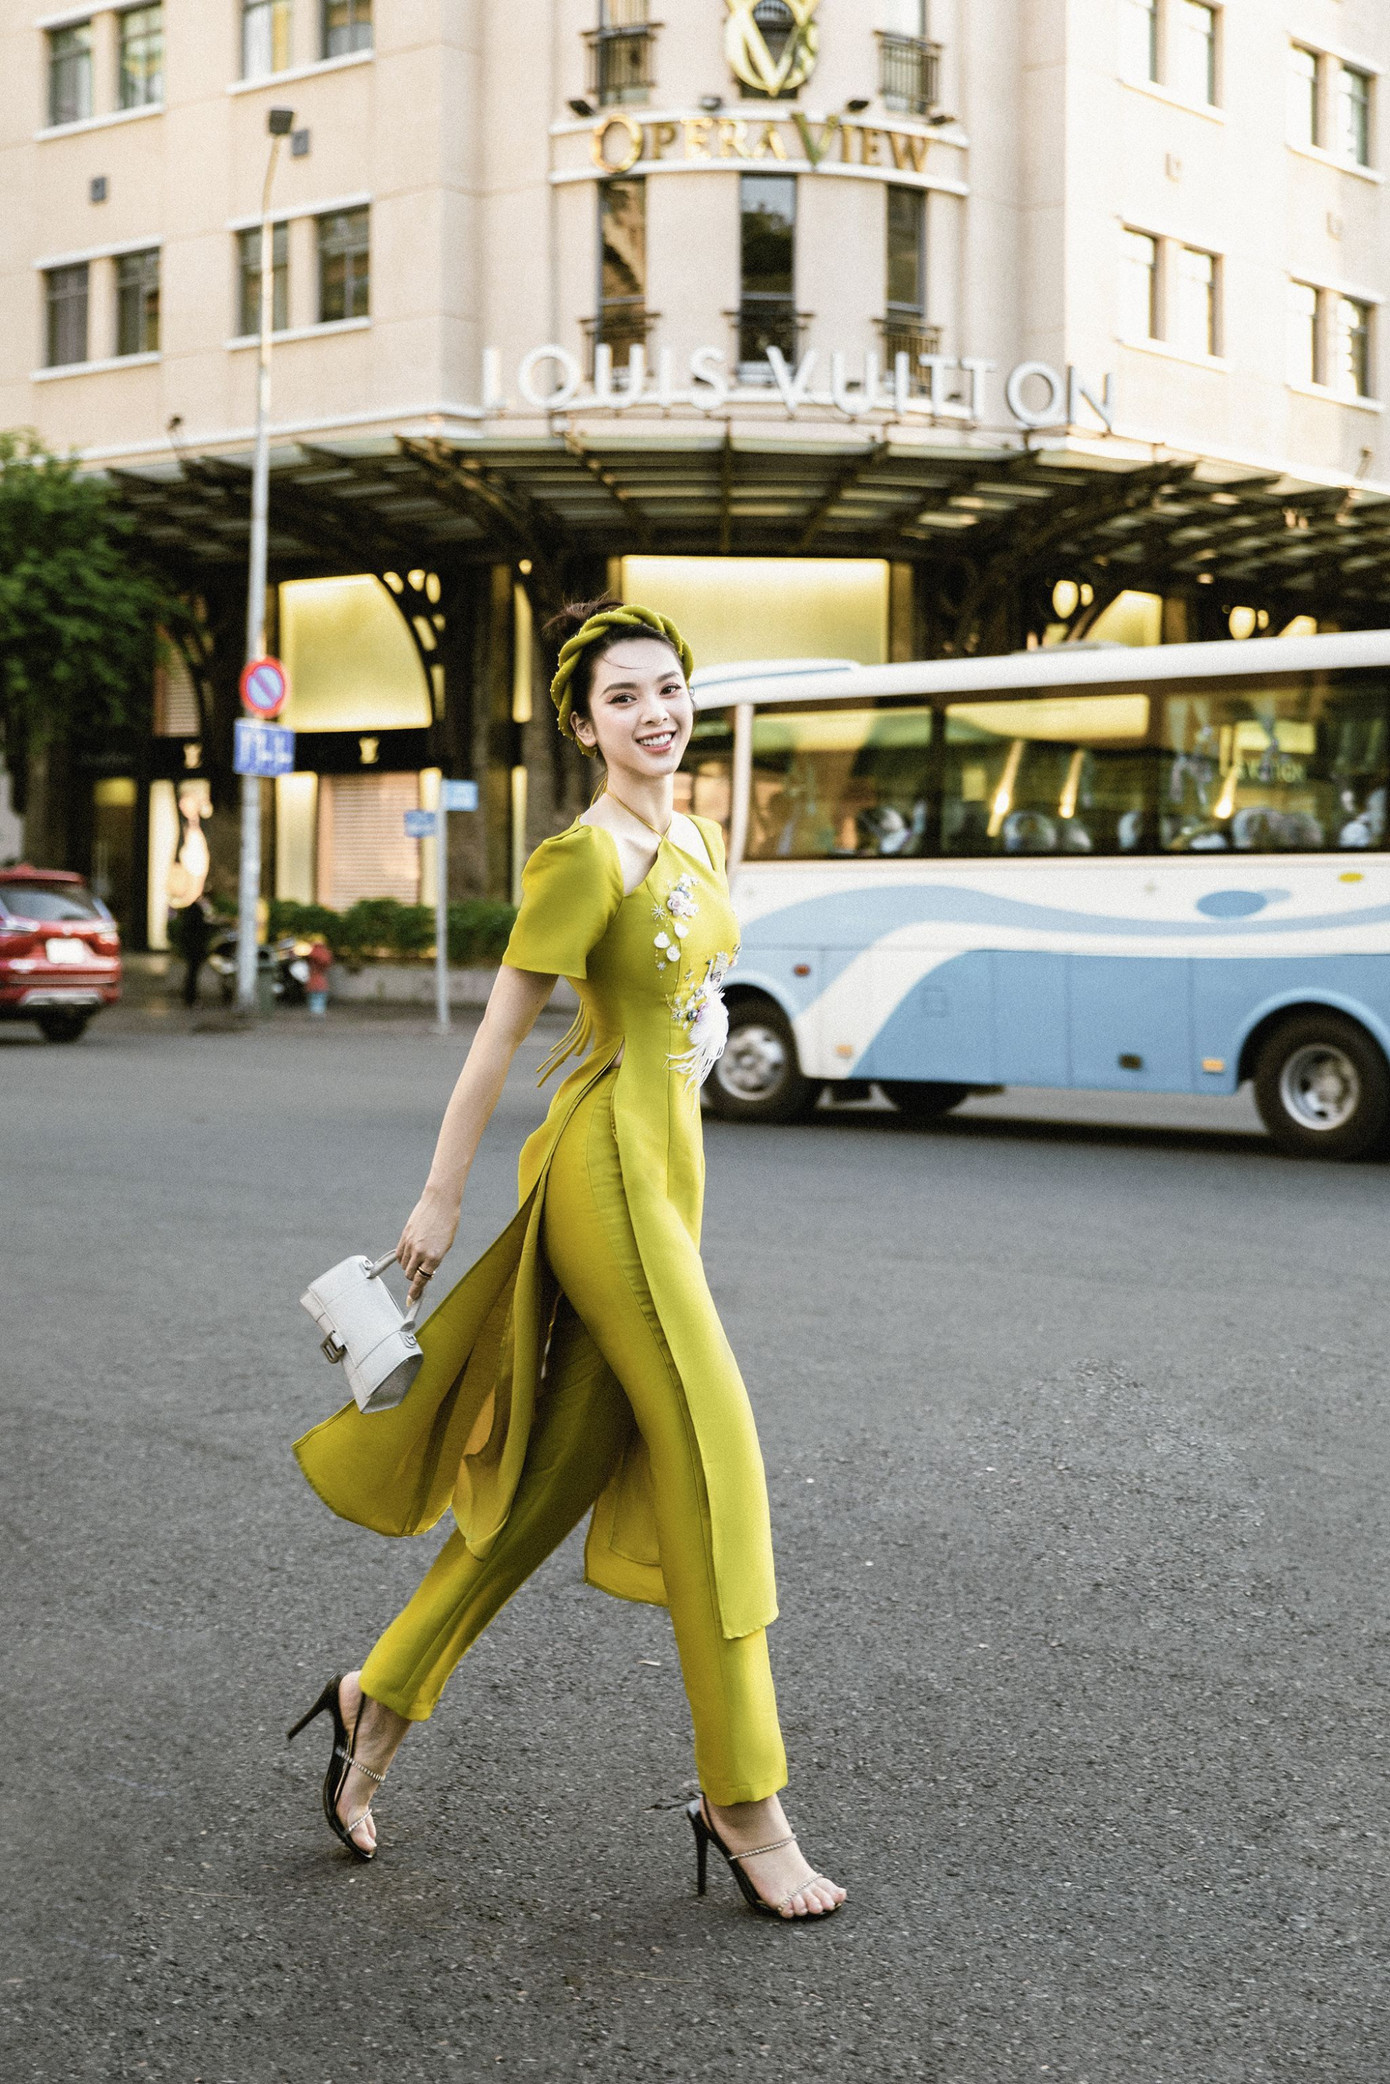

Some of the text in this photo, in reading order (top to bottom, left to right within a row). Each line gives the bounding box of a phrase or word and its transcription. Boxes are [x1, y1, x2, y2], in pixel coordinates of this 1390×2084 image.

[593, 112, 932, 173] OPERA VIEW
[482, 342, 1114, 434] LOUIS VUITTON
